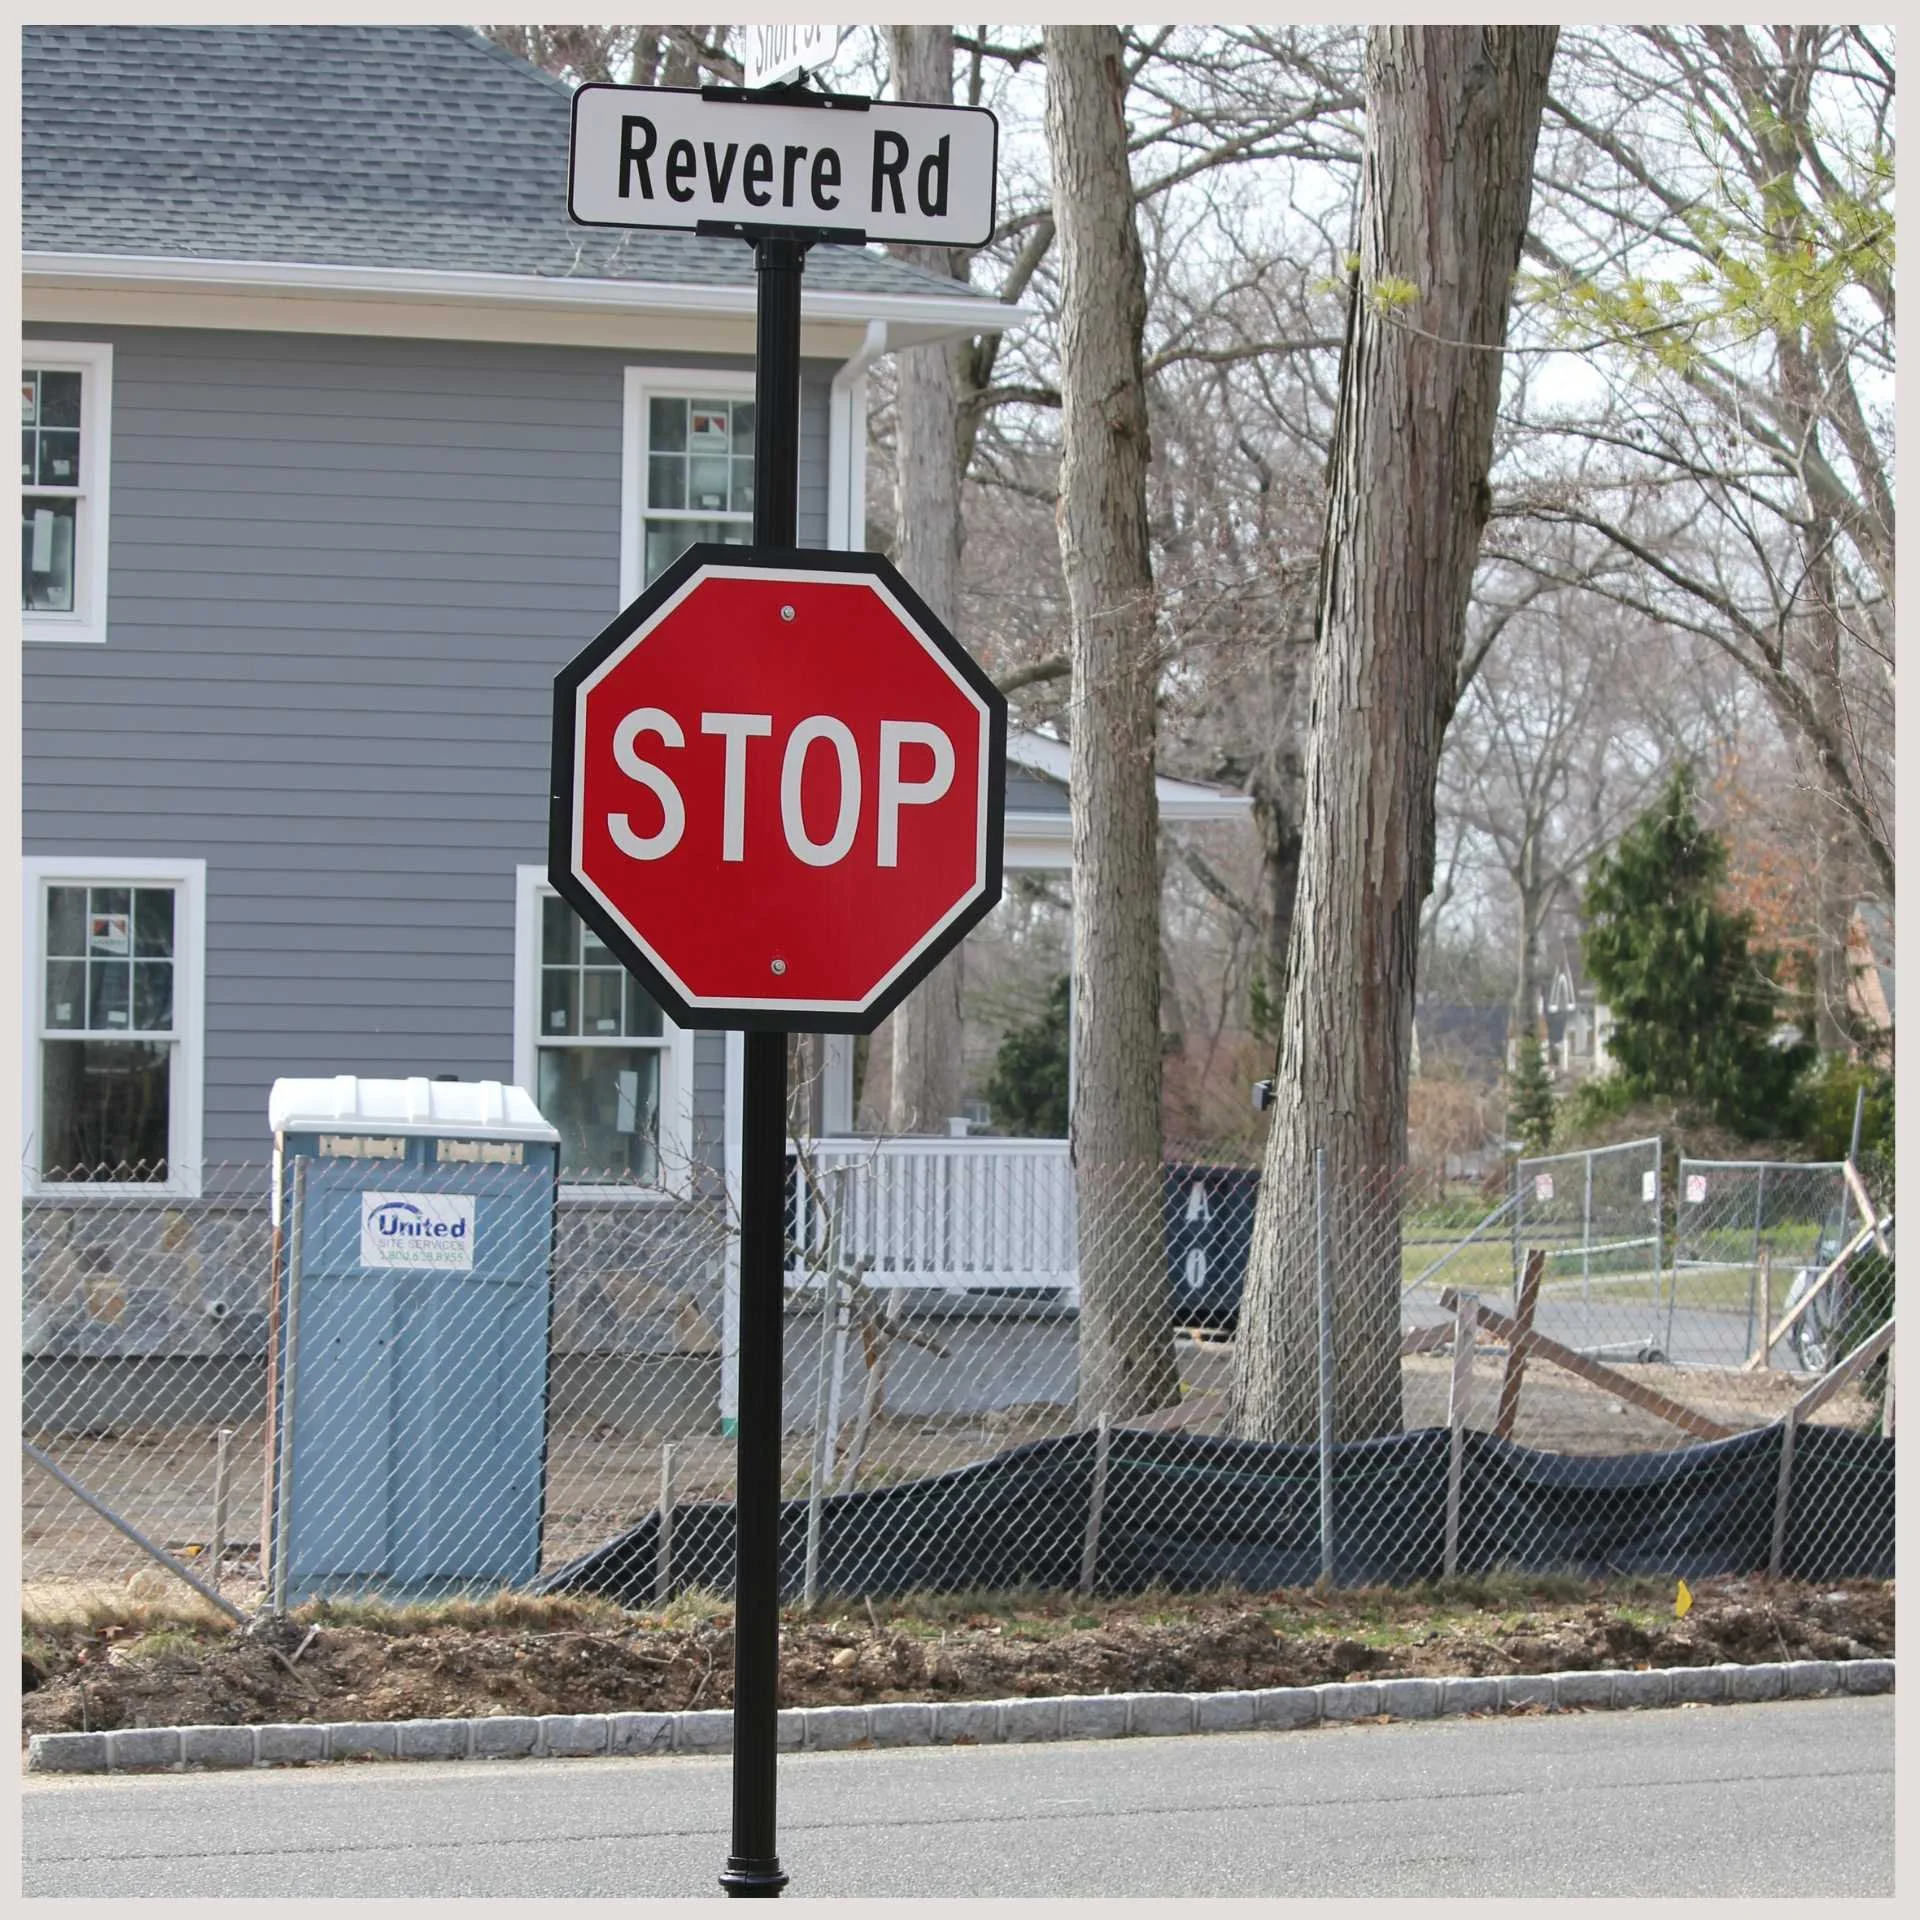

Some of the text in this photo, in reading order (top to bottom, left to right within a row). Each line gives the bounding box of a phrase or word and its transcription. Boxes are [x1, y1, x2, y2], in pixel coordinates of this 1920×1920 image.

[618, 115, 950, 217] Revere Rd
[607, 707, 956, 868] STOP
[379, 1215, 466, 1237] United
[379, 1238, 465, 1250] SITE SERVICES
